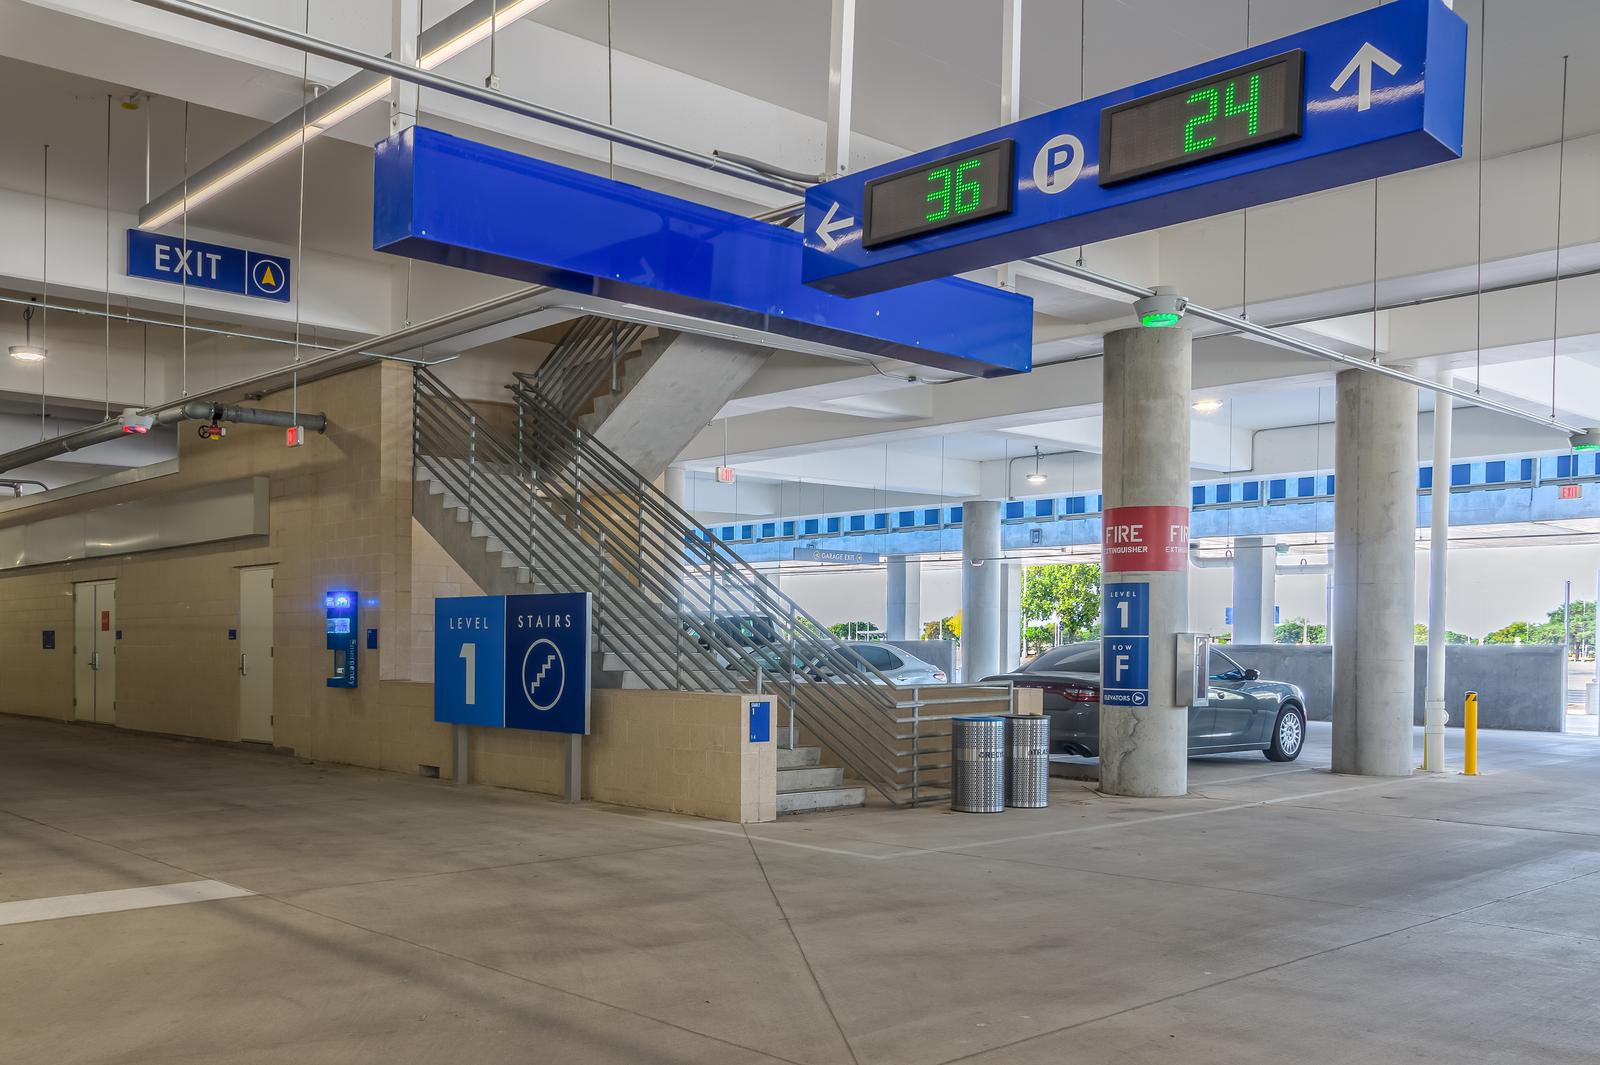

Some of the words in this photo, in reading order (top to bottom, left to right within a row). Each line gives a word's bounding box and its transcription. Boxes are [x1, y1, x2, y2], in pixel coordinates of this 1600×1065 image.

[1183, 73, 1260, 153] 24
[926, 158, 981, 222] 36
[155, 244, 222, 280] EXIT
[1105, 524, 1144, 544] FIRE
[822, 552, 843, 561] GARAGE
[450, 617, 489, 630] LEVEL
[518, 614, 572, 629] STAIRS
[1117, 601, 1129, 629] 1
[459, 643, 476, 705] 1
[1116, 655, 1129, 682] F
